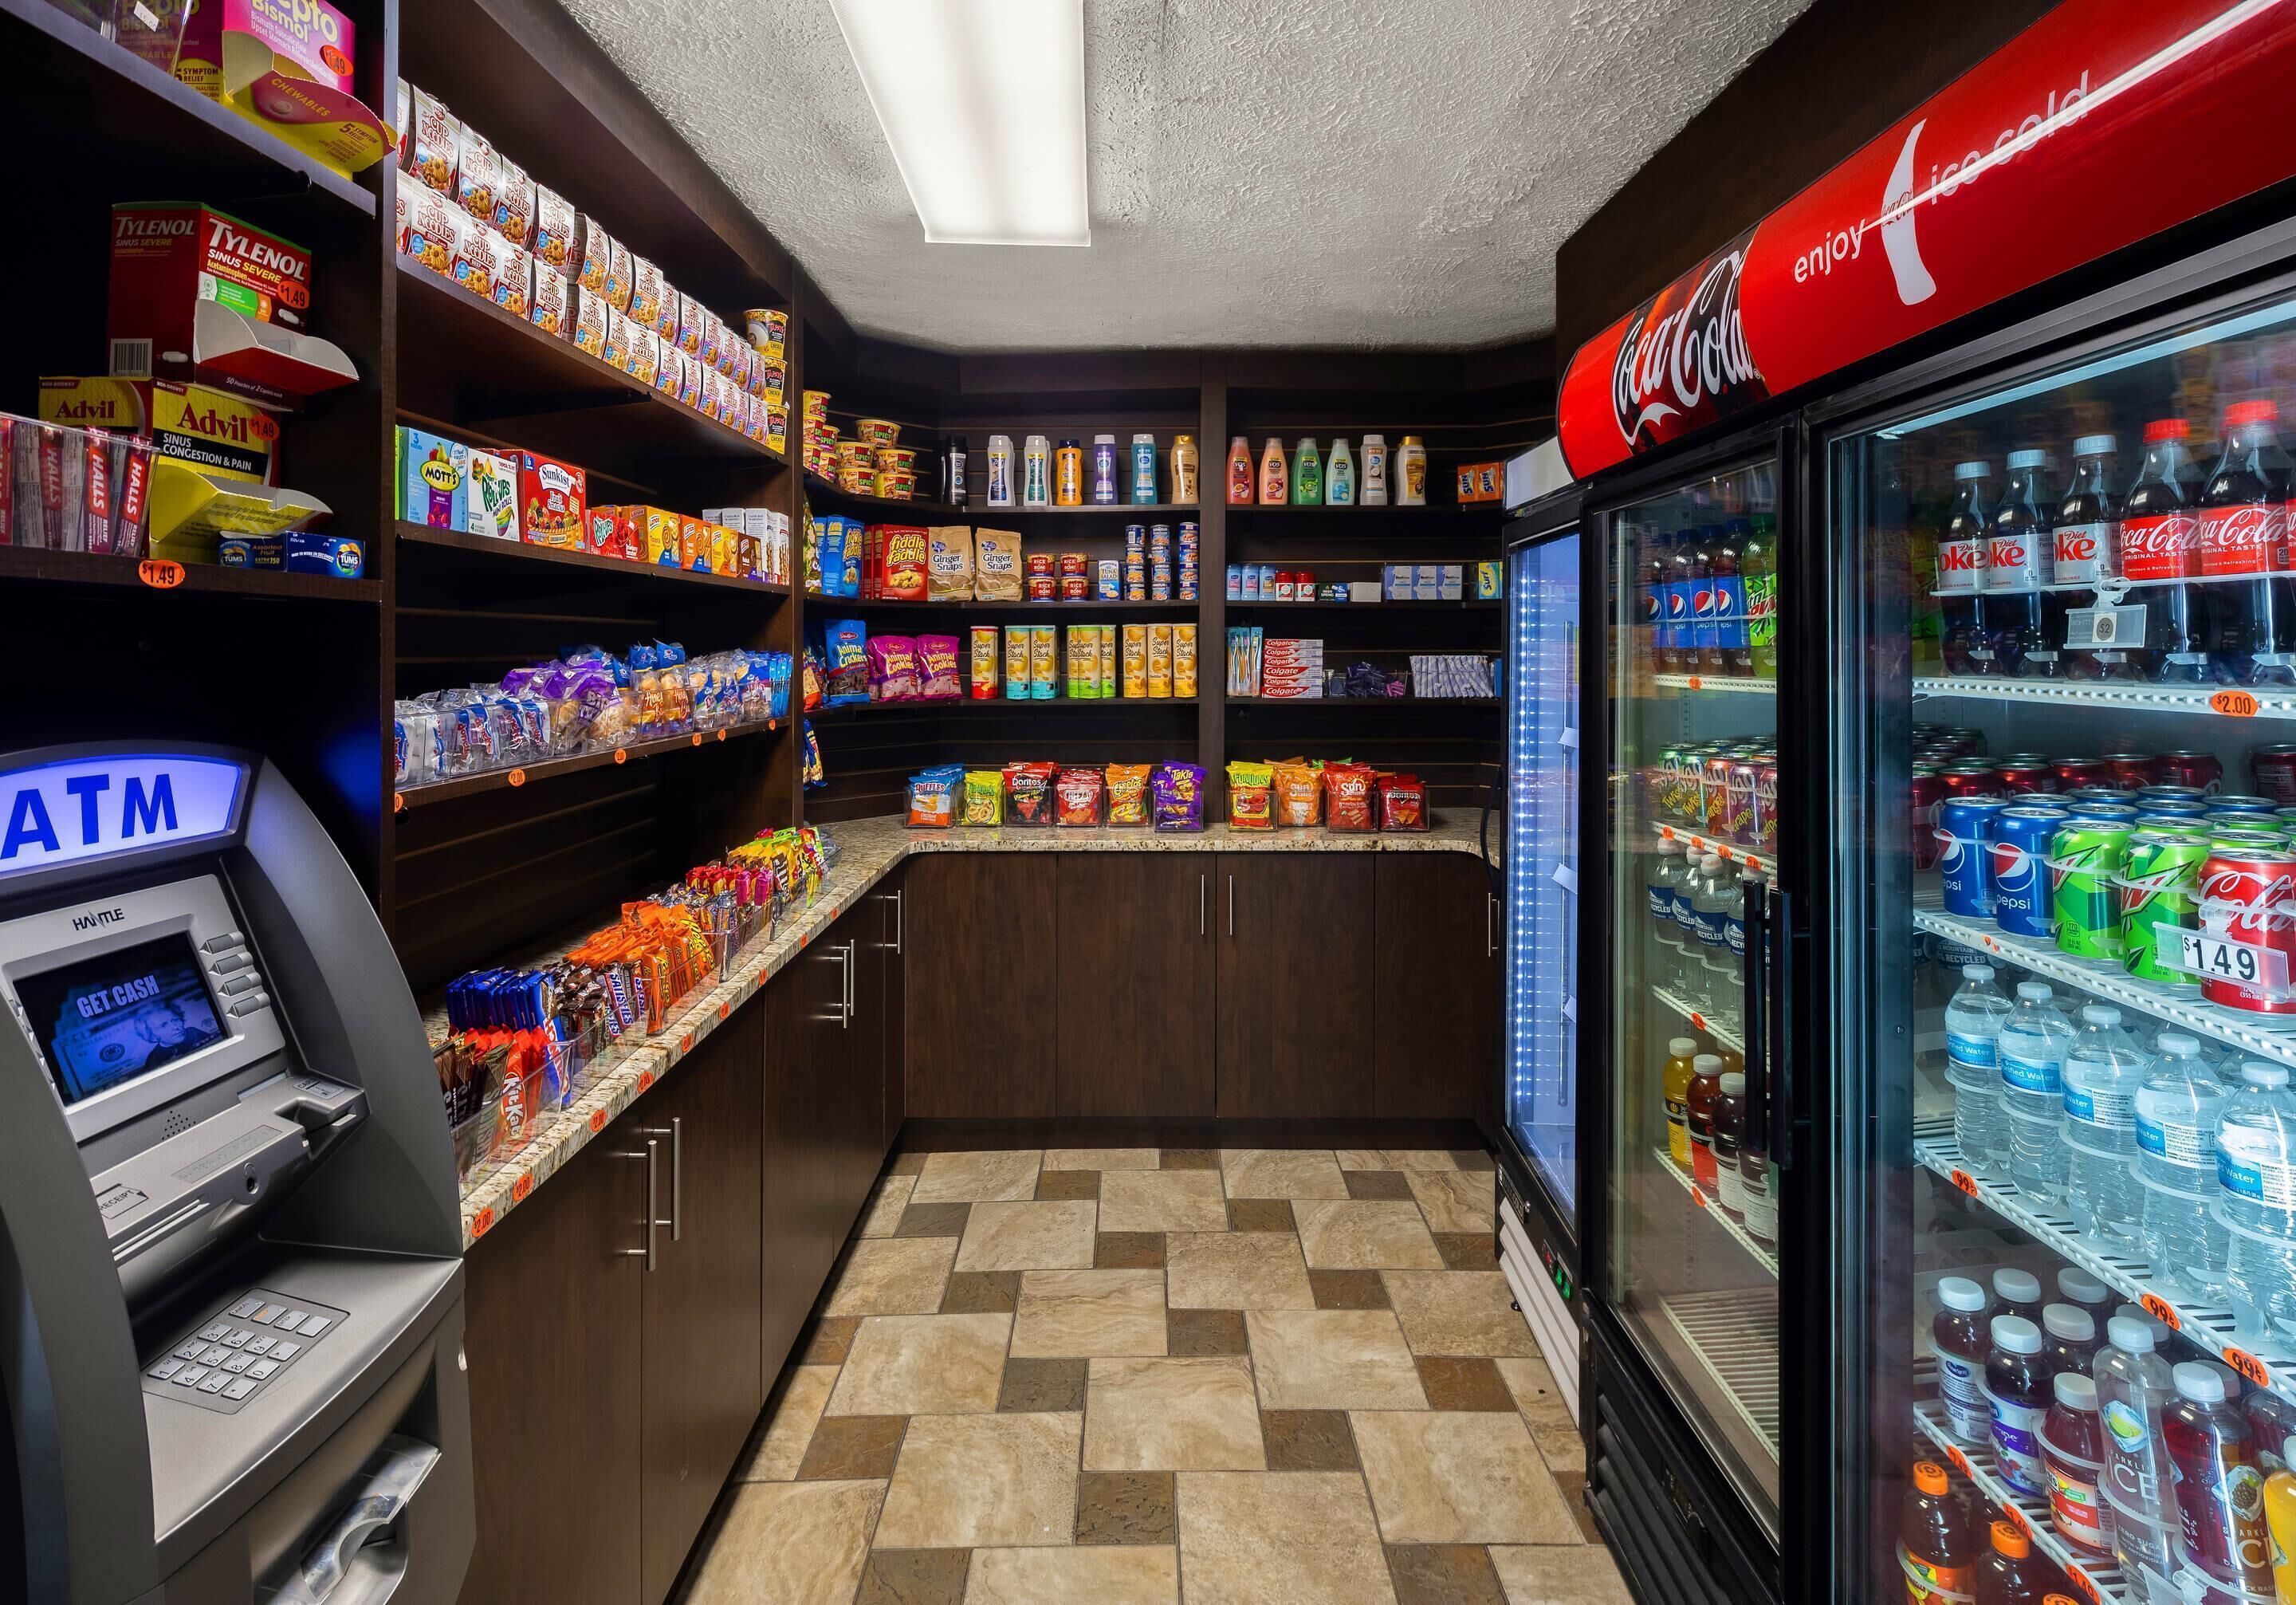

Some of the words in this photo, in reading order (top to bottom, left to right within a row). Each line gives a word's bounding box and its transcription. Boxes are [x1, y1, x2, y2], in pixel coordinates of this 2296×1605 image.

[251, 20, 268, 37] Upset
[271, 78, 331, 117] CHEWABLES
[339, 123, 356, 134] 5
[353, 126, 379, 144] SYMPTOM
[430, 116, 449, 137] CUP
[422, 120, 454, 158] NOODLES
[474, 151, 493, 171] CUP
[1794, 218, 1866, 284] enjoy
[1994, 69, 2090, 166] cold
[426, 205, 449, 226] CUP
[116, 216, 196, 238] TYLENOL
[418, 212, 456, 244] NOODLES
[115, 238, 139, 247] SINUS
[208, 218, 307, 281] TYLENOL
[472, 234, 491, 252] CUP
[464, 240, 497, 269] NOODLES
[207, 259, 248, 281] Acetaminophen
[208, 249, 242, 268] SINUS
[242, 262, 282, 285] SEVERE
[281, 282, 306, 308] $1.49
[1612, 250, 1754, 446] Coca-Cola
[157, 380, 184, 393] NON-DROWSY
[54, 399, 116, 419] Advil
[177, 401, 249, 443] Advil
[163, 432, 192, 448] SINUS
[163, 443, 222, 465] CONGESTION
[223, 458, 230, 466] &
[231, 458, 252, 471] PAIN
[47, 446, 63, 504] HALLS
[92, 453, 105, 509] HALLS
[425, 466, 458, 486] MOTT'S
[541, 466, 571, 489] Sunkist
[1480, 472, 1494, 494] SUN
[127, 462, 143, 516] HALLS
[1461, 474, 1474, 494] SUN
[549, 491, 563, 504] Fruit
[548, 500, 565, 513] Snacks
[470, 523, 475, 532] 4
[2064, 530, 2087, 540] Diet
[890, 535, 925, 550] fiddle
[1957, 542, 1980, 552] Diet
[1996, 539, 2018, 549] Diet
[224, 555, 244, 564] TUMS
[340, 555, 358, 565] TUMS
[887, 548, 926, 566] faddle
[933, 554, 961, 567] Ginger
[982, 553, 1012, 565] Ginger
[1940, 546, 1989, 572] oke
[142, 563, 176, 584] $1.49
[937, 562, 964, 573] Snaps
[987, 561, 1013, 572] Snaps
[1483, 570, 1492, 591] Surf
[973, 641, 991, 650] Super
[1008, 641, 1024, 650] Super
[1033, 641, 1050, 650] Super
[1078, 641, 1094, 650] Super
[839, 653, 868, 668] Crackers
[886, 651, 912, 663] Animal
[928, 651, 954, 663] Animal
[887, 660, 914, 675] Cookies
[930, 660, 957, 673] Cookies
[1266, 686, 1299, 695] Colgate
[2216, 693, 2251, 715] $2.00
[1012, 777, 1042, 787] Doritos
[1172, 769, 1193, 782] Takis
[1235, 773, 1270, 786] FUNYUNS
[914, 782, 946, 793] RUFFLES
[1113, 778, 1142, 795] Cheetos
[1290, 783, 1310, 797] Sun
[1341, 781, 1365, 797] Sun
[1662, 785, 1682, 808] Twist
[1683, 791, 1700, 816] Twist
[0, 773, 179, 860] ATM
[1996, 894, 2031, 911] pepsi
[73, 908, 124, 931] HANTLE
[2067, 922, 2078, 930] 170
[1697, 930, 1724, 940] RECYCLED
[1942, 945, 1975, 954] MOUNTAIN
[1945, 954, 1986, 964] RECYCLED
[2184, 938, 2256, 981] $1.49
[77, 992, 112, 1019] GET
[112, 974, 160, 1007] CASH
[1964, 1047, 1990, 1056] Water
[2026, 1072, 2054, 1081] Water
[2066, 1095, 2089, 1108] Water
[1957, 1172, 1977, 1194] 99¢
[2225, 1168, 2255, 1184] Water
[516, 1176, 531, 1196] $2.00
[100, 1189, 136, 1211] RECEIPT
[474, 1213, 491, 1233] $2.00
[2149, 1300, 2177, 1328] 99¢
[2232, 1353, 2263, 1383] 99¢
[184, 1376, 195, 1385] 4
[2117, 1524, 2135, 1540] ZERO
